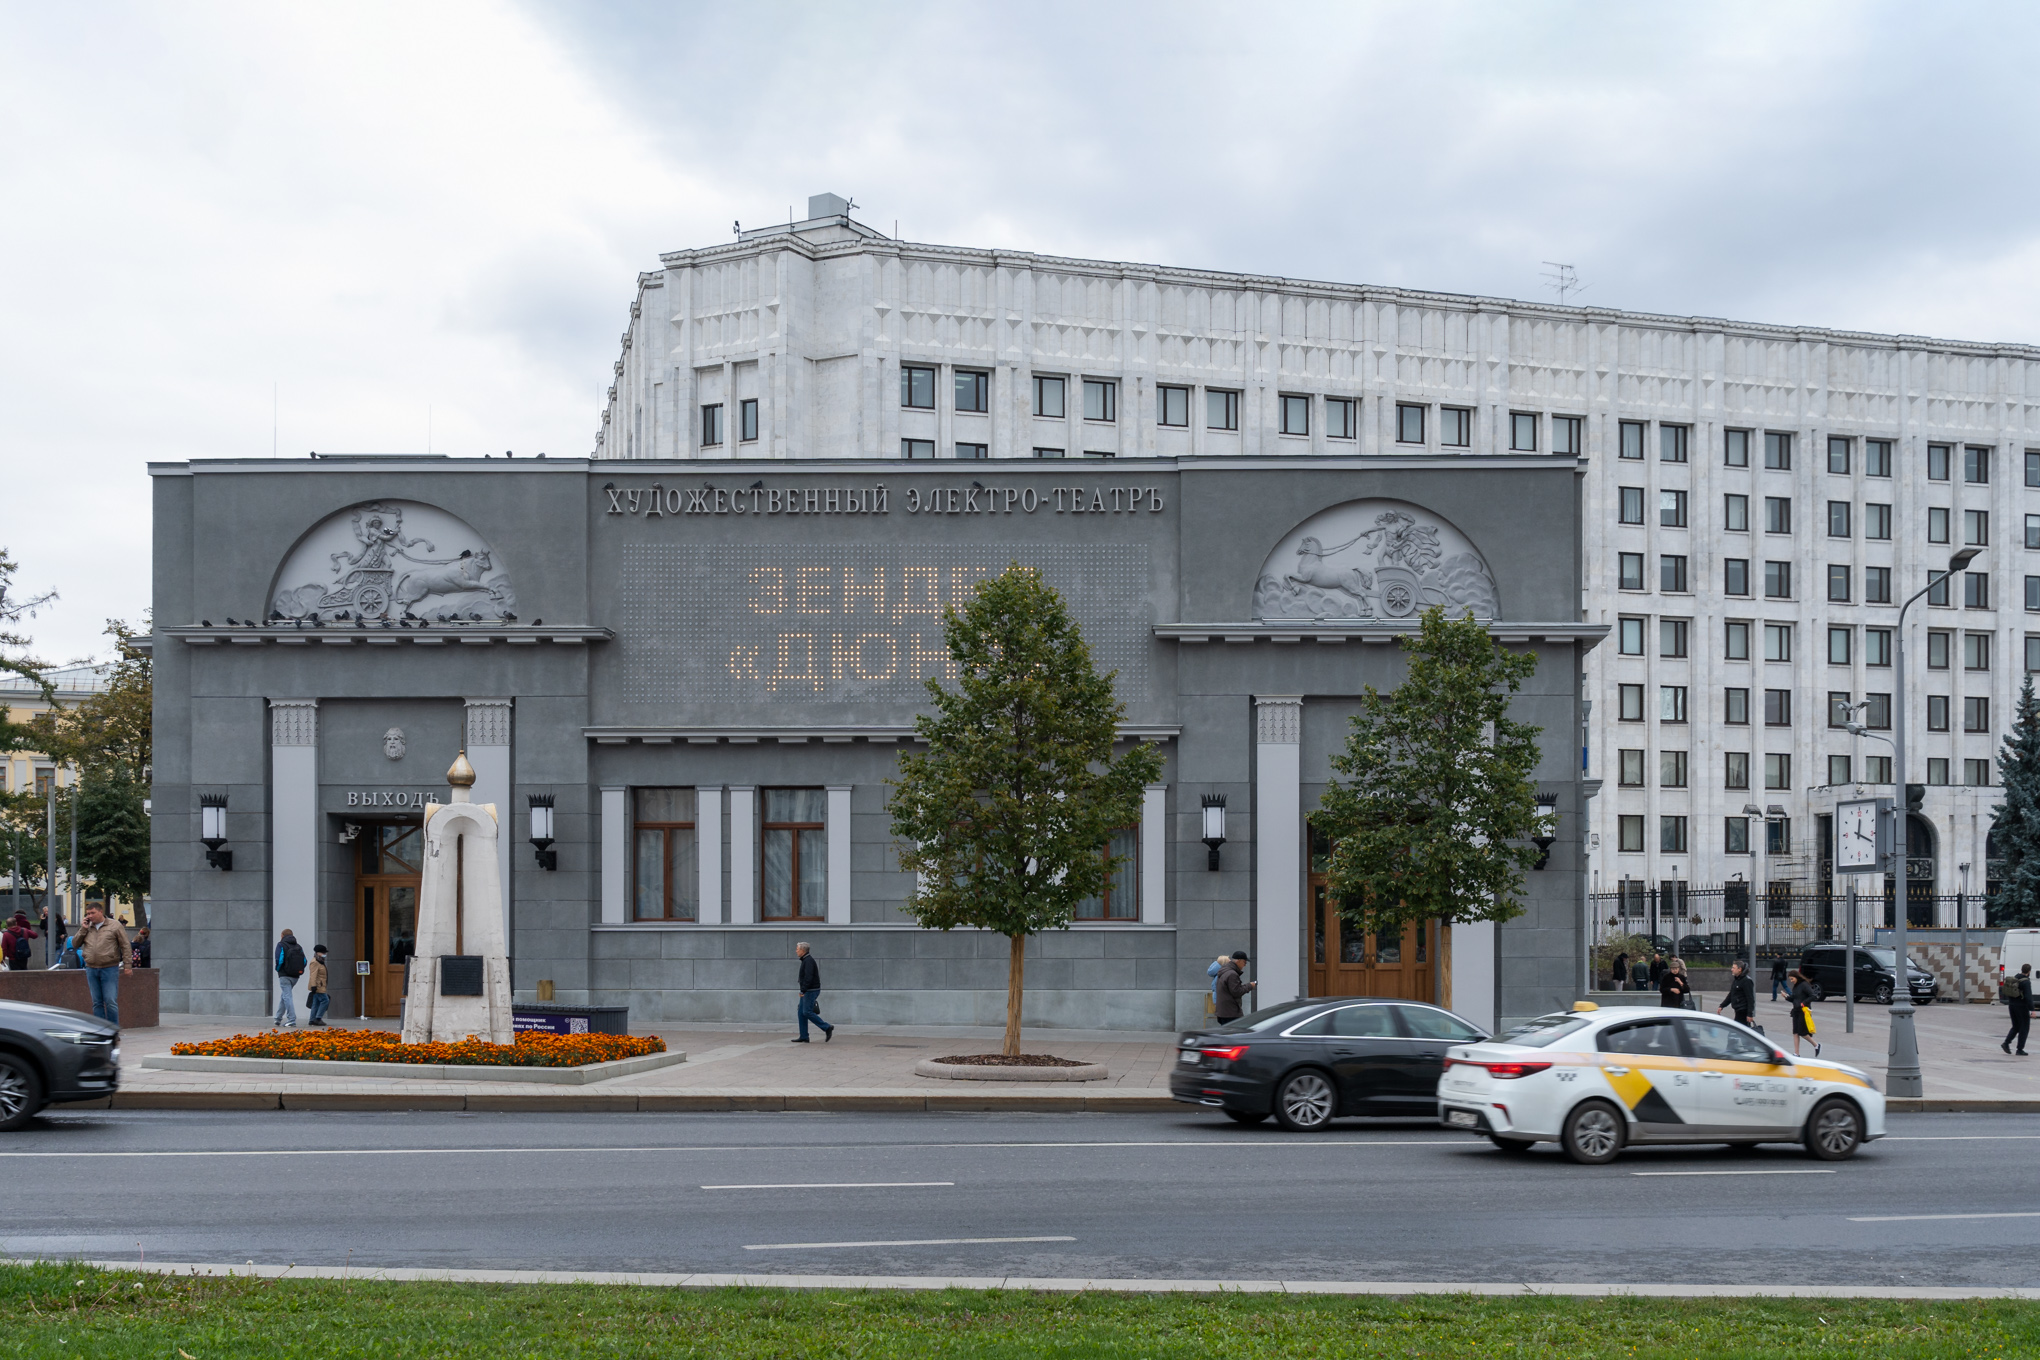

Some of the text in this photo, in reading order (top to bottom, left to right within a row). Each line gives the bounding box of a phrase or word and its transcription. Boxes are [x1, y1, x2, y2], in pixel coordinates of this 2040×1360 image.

[606, 483, 1164, 517] ХУДОЖЕСТВЕННЫЙ ЭЛЕКТРО-ТЕАТРЪ
[347, 791, 439, 808] ВЫХОДЪ
